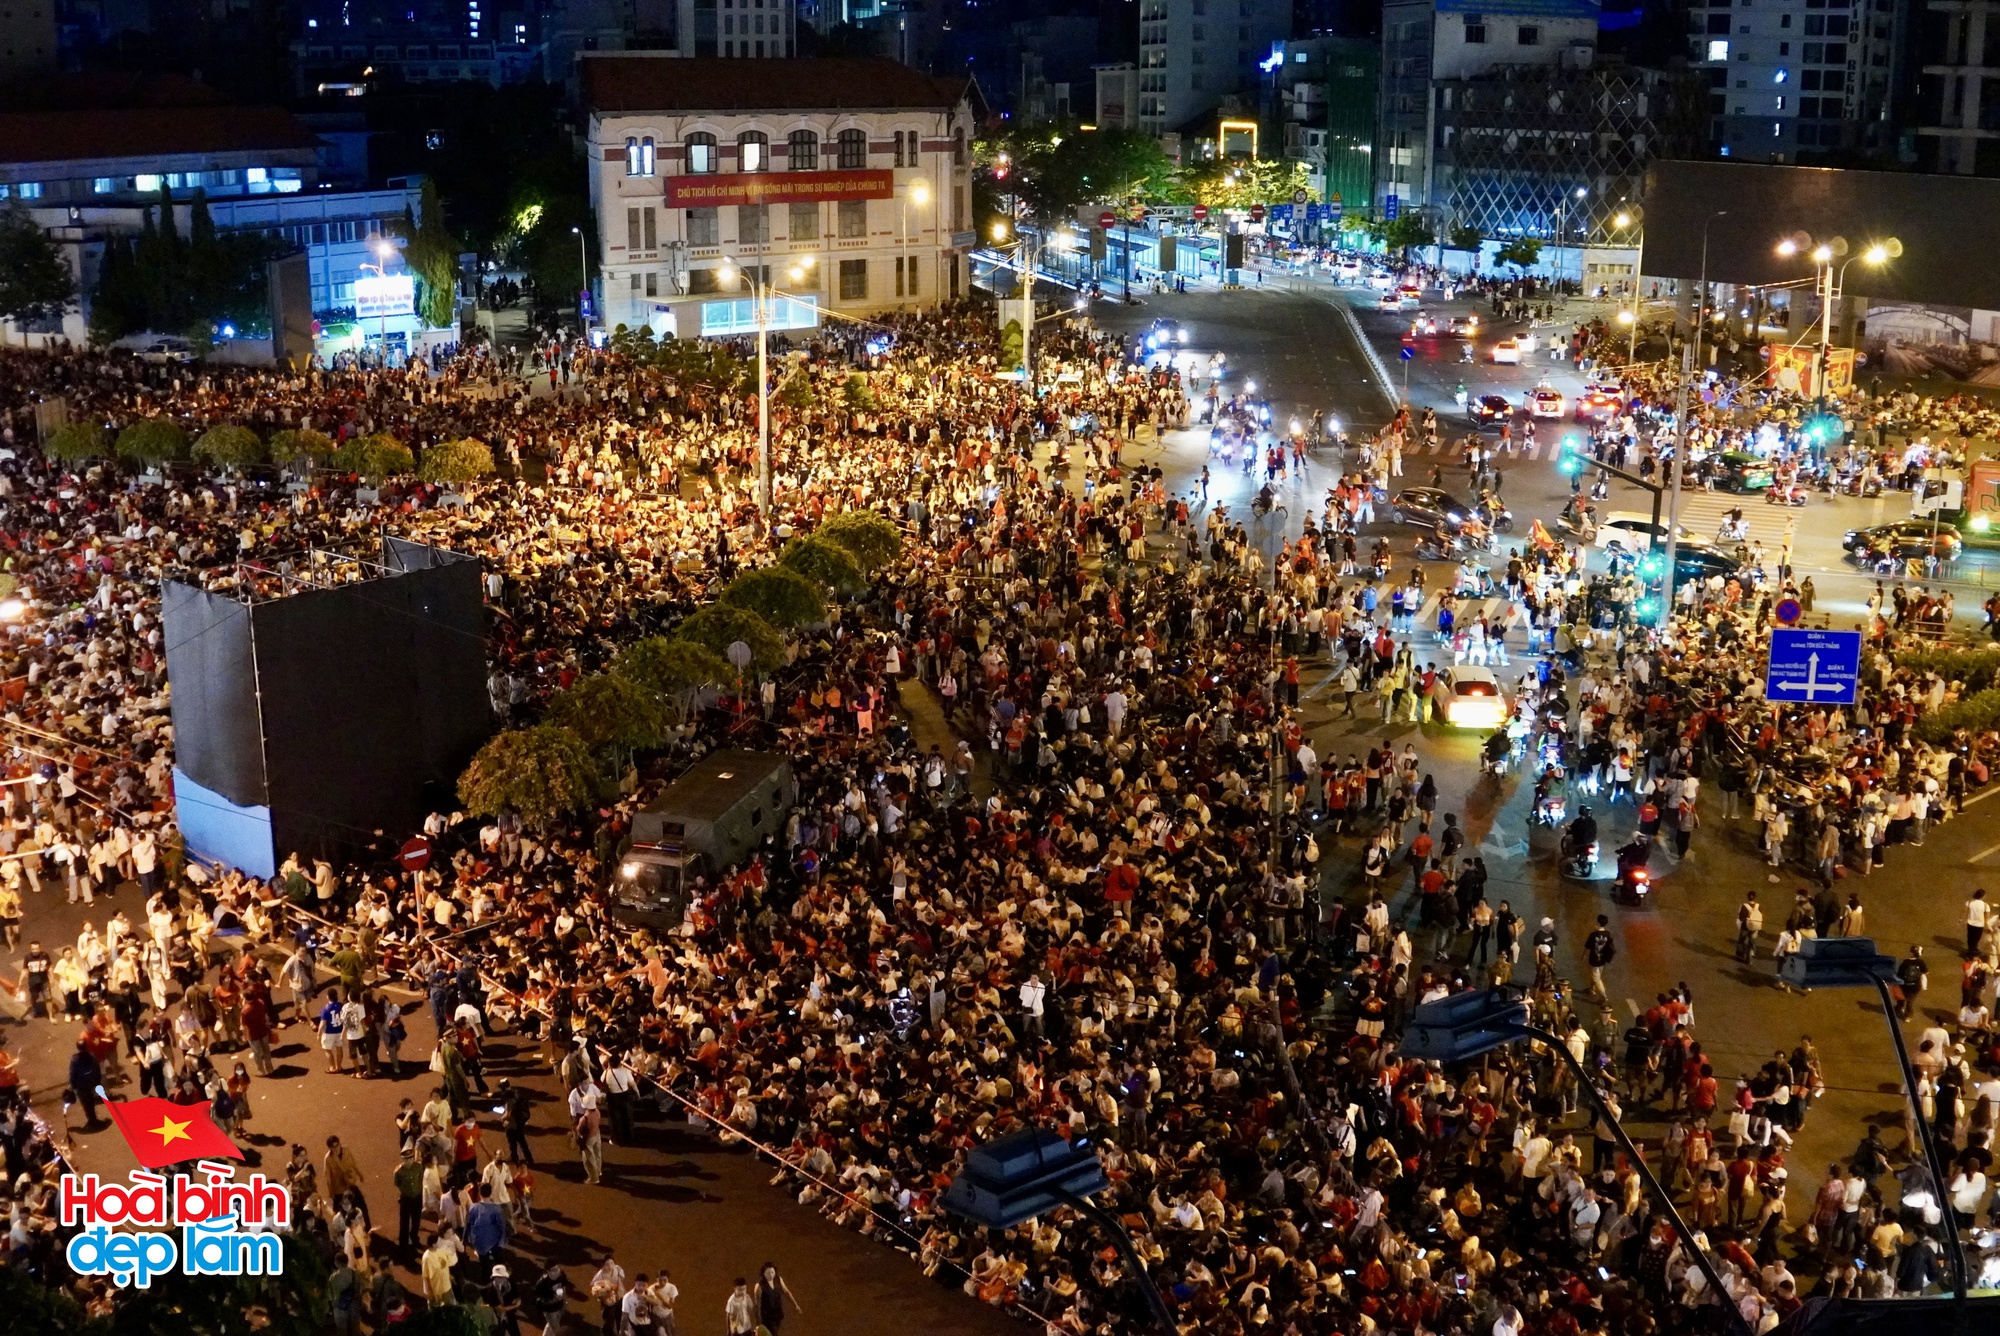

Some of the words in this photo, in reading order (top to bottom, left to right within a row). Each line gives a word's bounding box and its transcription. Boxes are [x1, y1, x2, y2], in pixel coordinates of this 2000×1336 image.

[677, 185, 690, 198] CHỦ
[691, 187, 706, 199] TỊCH
[707, 184, 716, 197] HỒ
[717, 185, 727, 196] CHÍ
[728, 186, 745, 196] MINH
[764, 182, 781, 194] SỐNG
[782, 182, 793, 194] MÃI
[794, 183, 814, 193] TRONG
[814, 182, 823, 194] SỰ
[823, 181, 845, 193] NGHIỆP
[845, 179, 857, 191] CỦA
[857, 180, 877, 190] CHÚNG
[878, 181, 885, 190] TA
